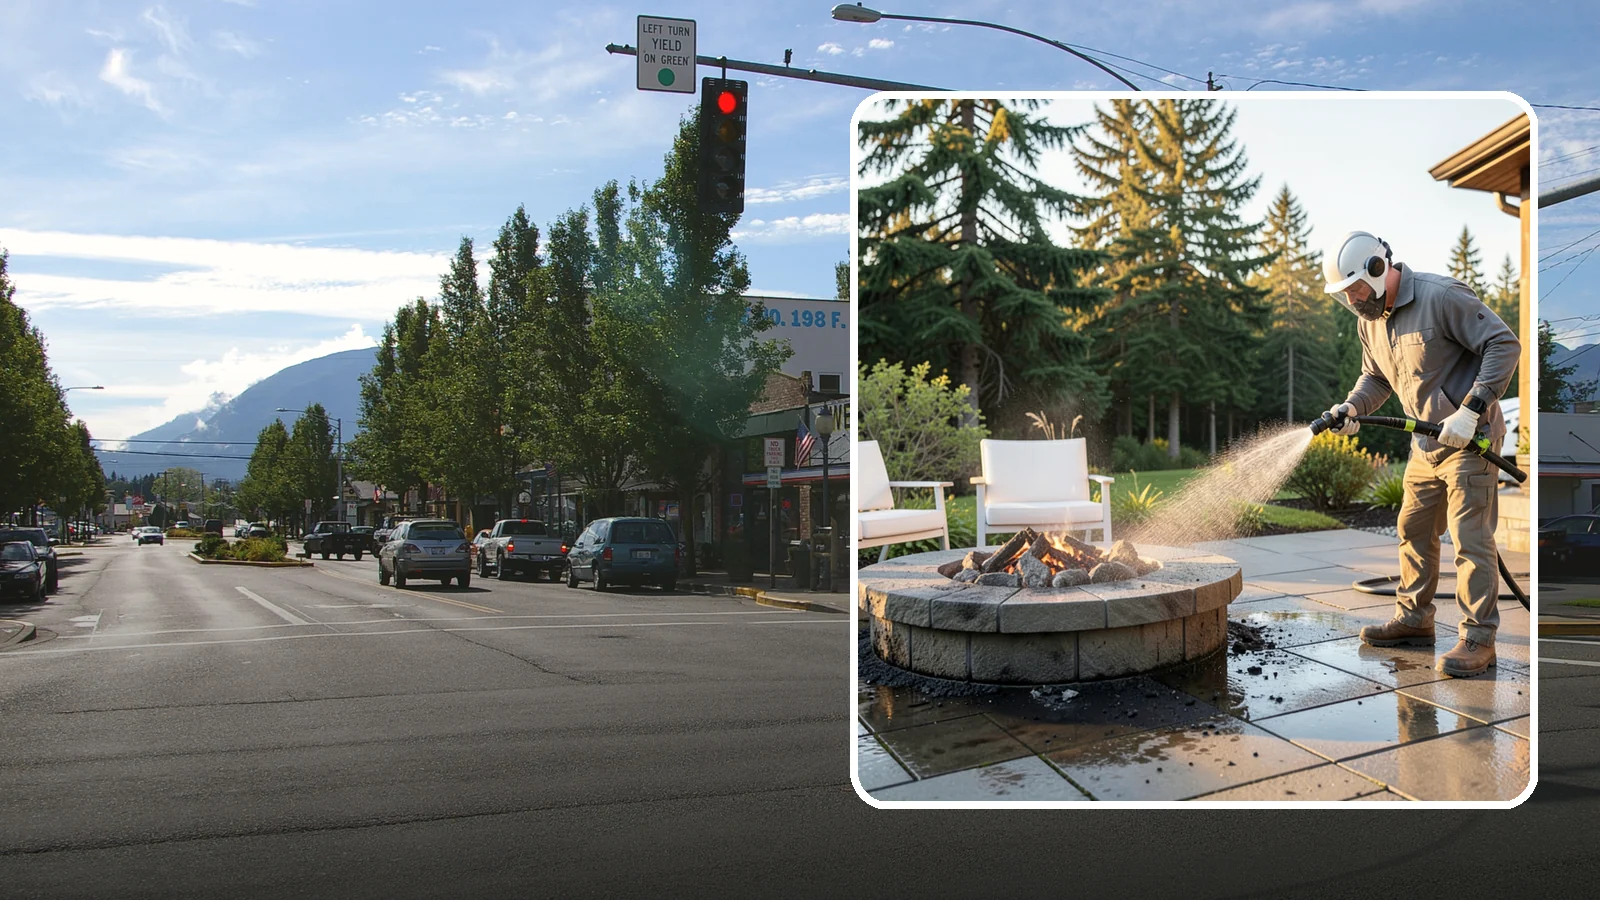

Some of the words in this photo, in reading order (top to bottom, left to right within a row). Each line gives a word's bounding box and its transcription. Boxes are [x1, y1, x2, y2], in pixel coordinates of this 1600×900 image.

[643, 24, 663, 34] LEFT
[668, 26, 690, 36] TURN
[652, 38, 682, 51] YIELD
[644, 54, 656, 63] ON
[661, 55, 688, 66] GREEN
[792, 310, 826, 328] 198
[832, 312, 846, 328] F.
